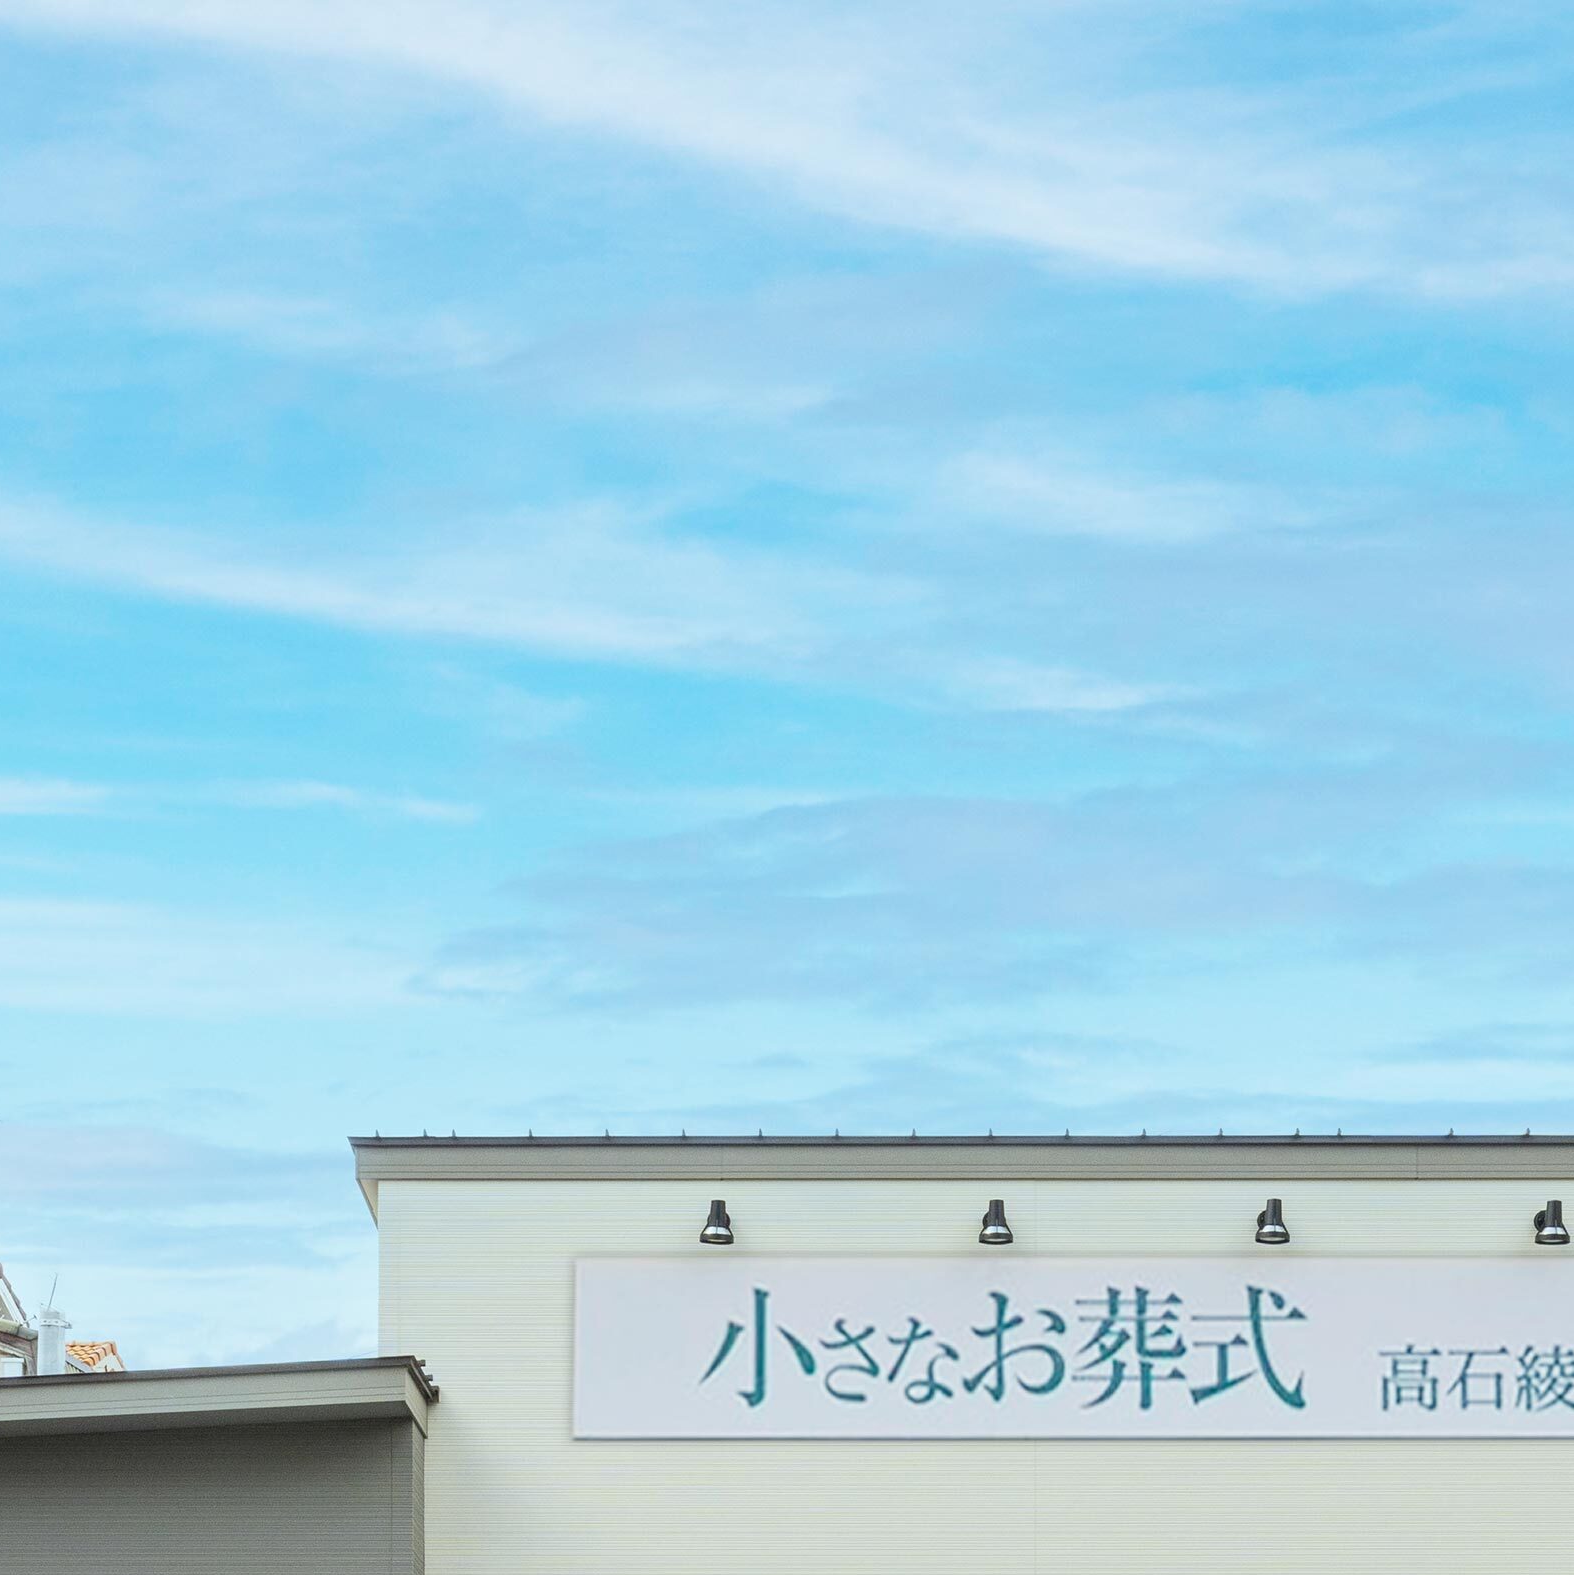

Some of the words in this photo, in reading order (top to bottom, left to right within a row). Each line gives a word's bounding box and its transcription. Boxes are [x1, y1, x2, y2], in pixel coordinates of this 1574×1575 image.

[700, 1284, 1306, 1409] 小さなお葬式
